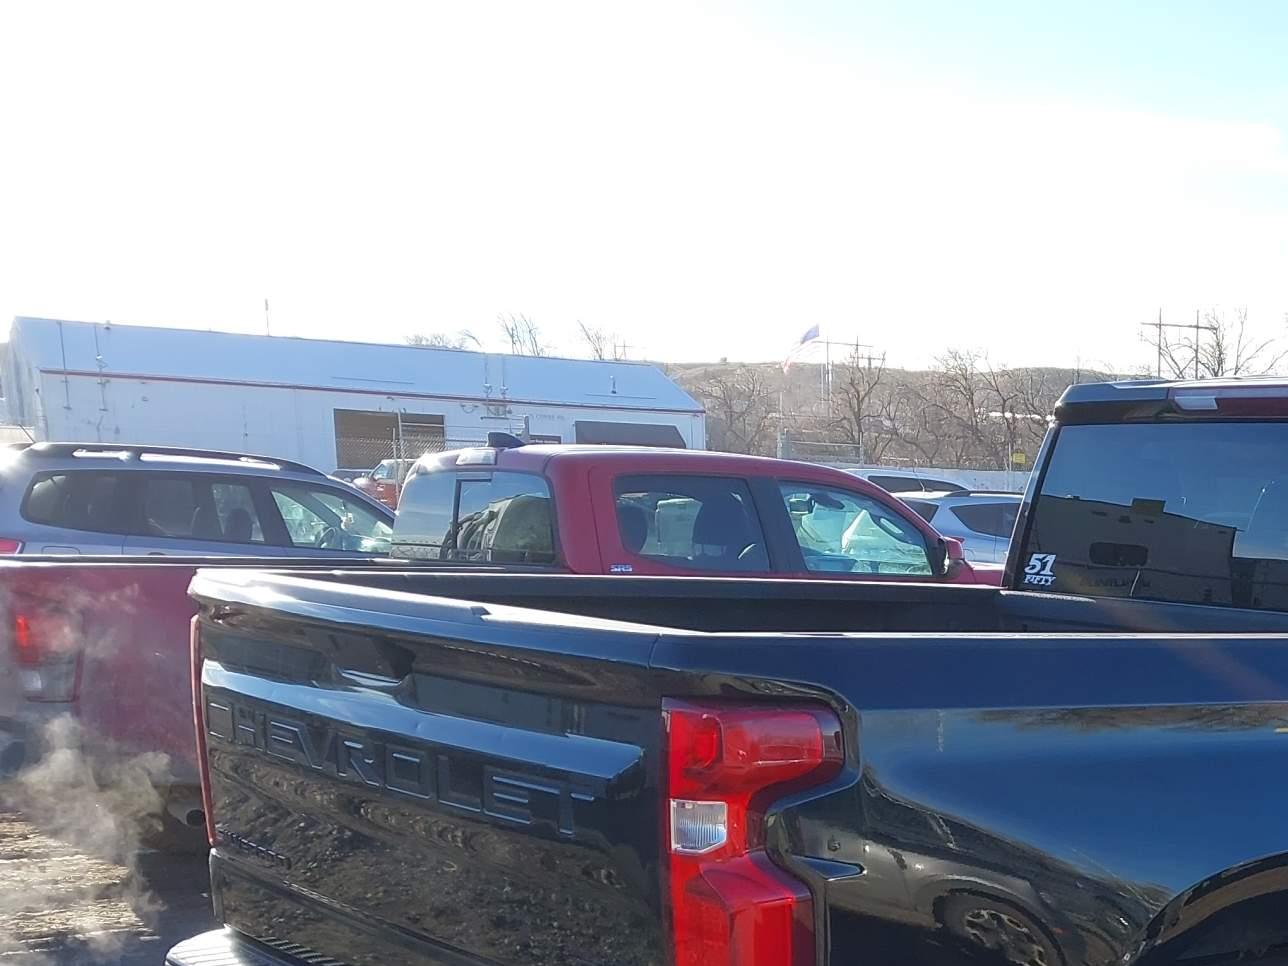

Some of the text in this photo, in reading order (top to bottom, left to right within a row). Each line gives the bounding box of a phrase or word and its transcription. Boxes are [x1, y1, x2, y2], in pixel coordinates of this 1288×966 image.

[1024, 553, 1057, 575] 51
[1023, 574, 1057, 586] FIFTY
[207, 700, 596, 839] CHEVROLET
